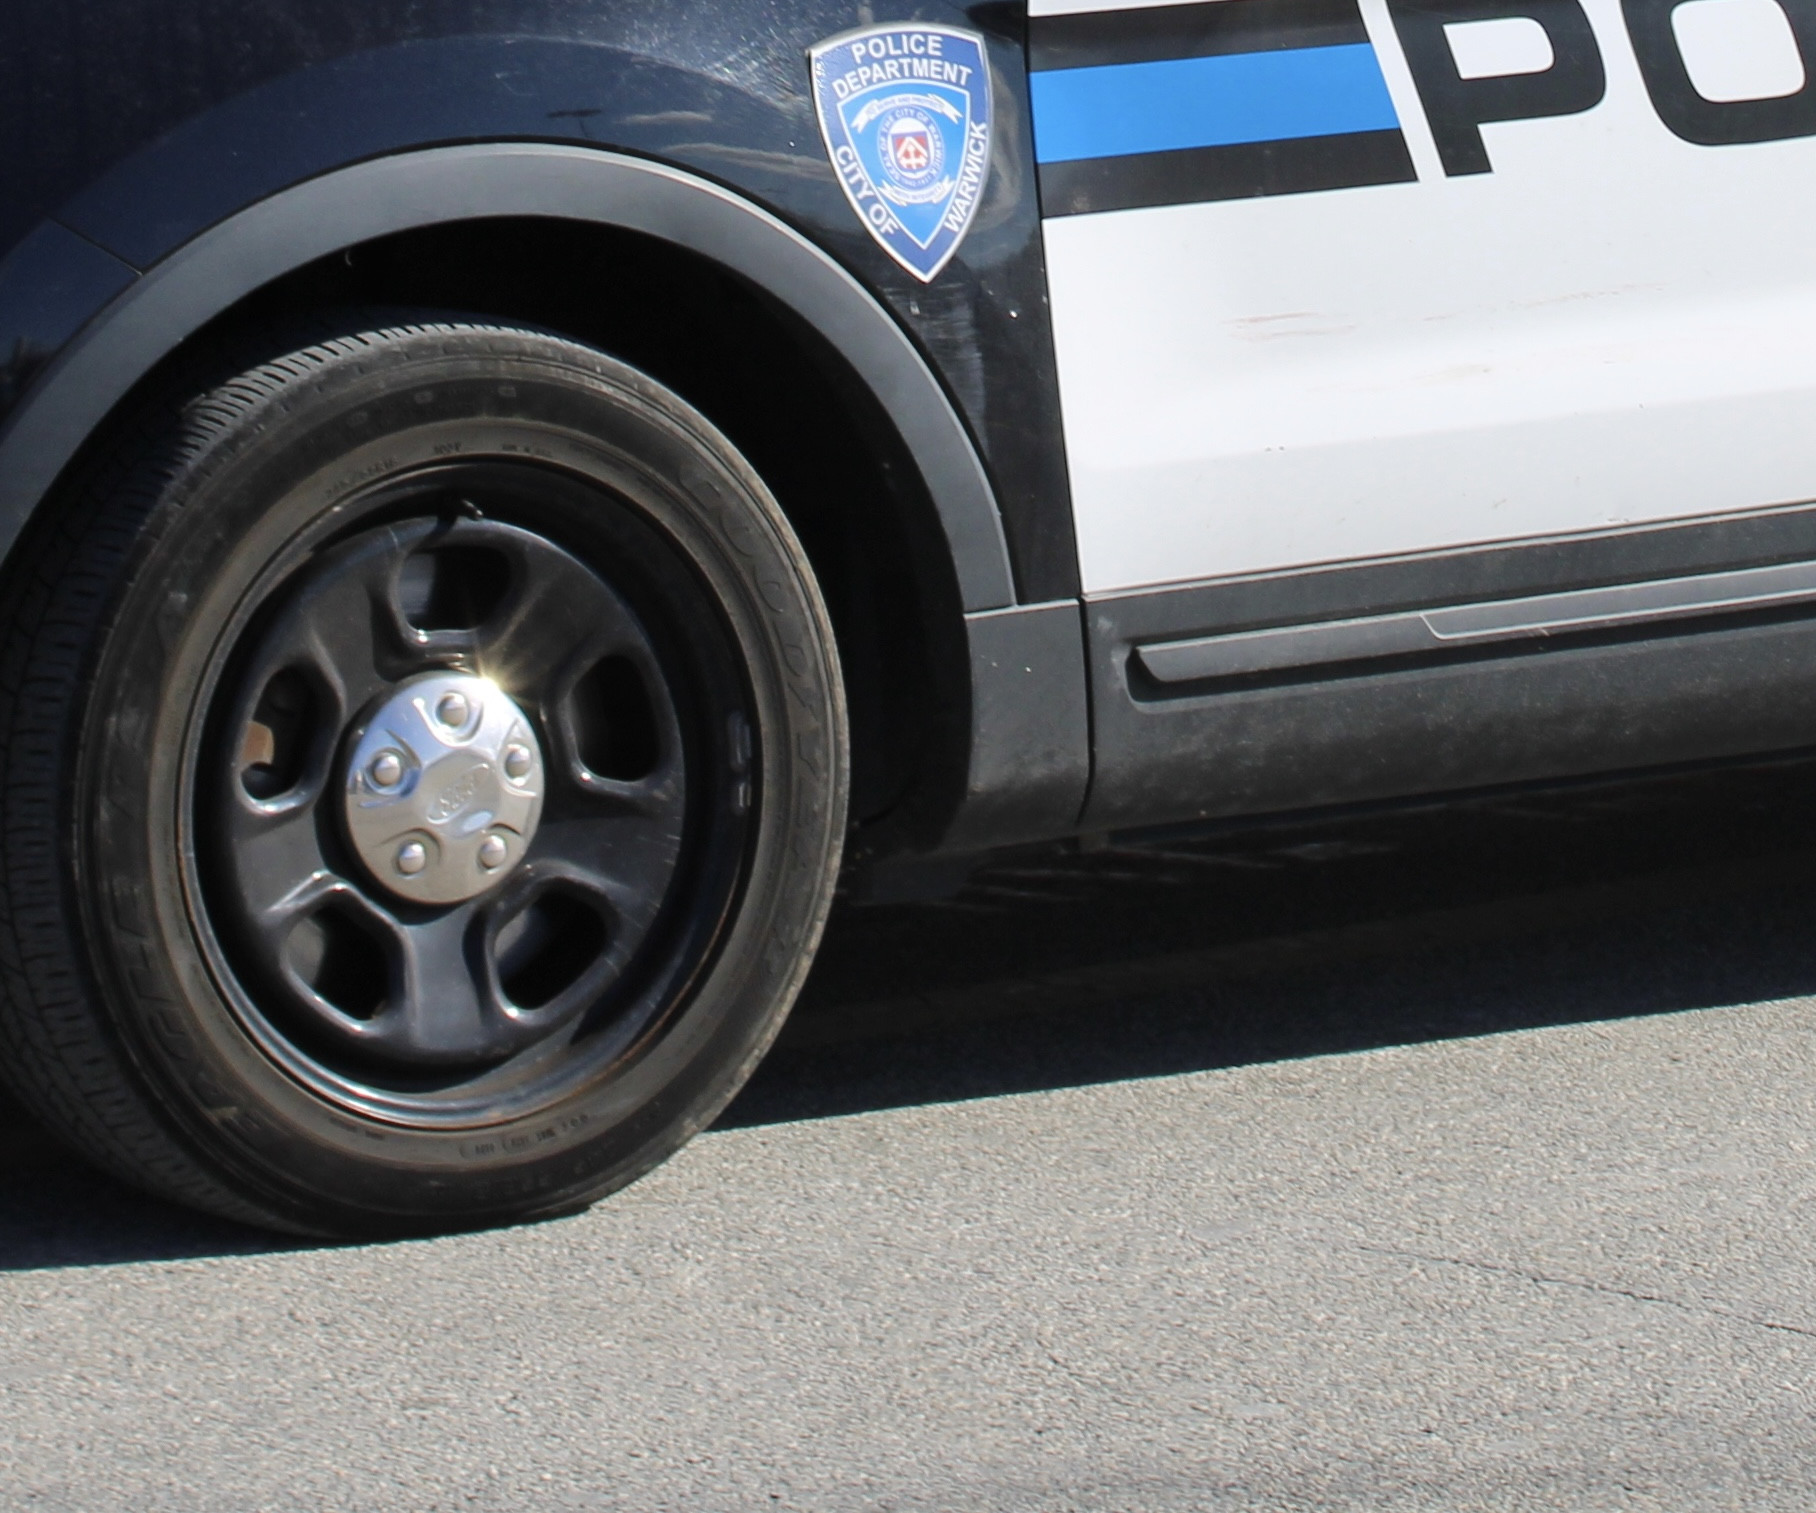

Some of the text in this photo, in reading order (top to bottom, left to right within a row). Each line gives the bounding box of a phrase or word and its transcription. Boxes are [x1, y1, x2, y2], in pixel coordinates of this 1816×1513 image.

[852, 34, 944, 64] POLICE
[832, 58, 973, 99] DEPARTMENT
[835, 121, 988, 236] CITY OF WARWICK
